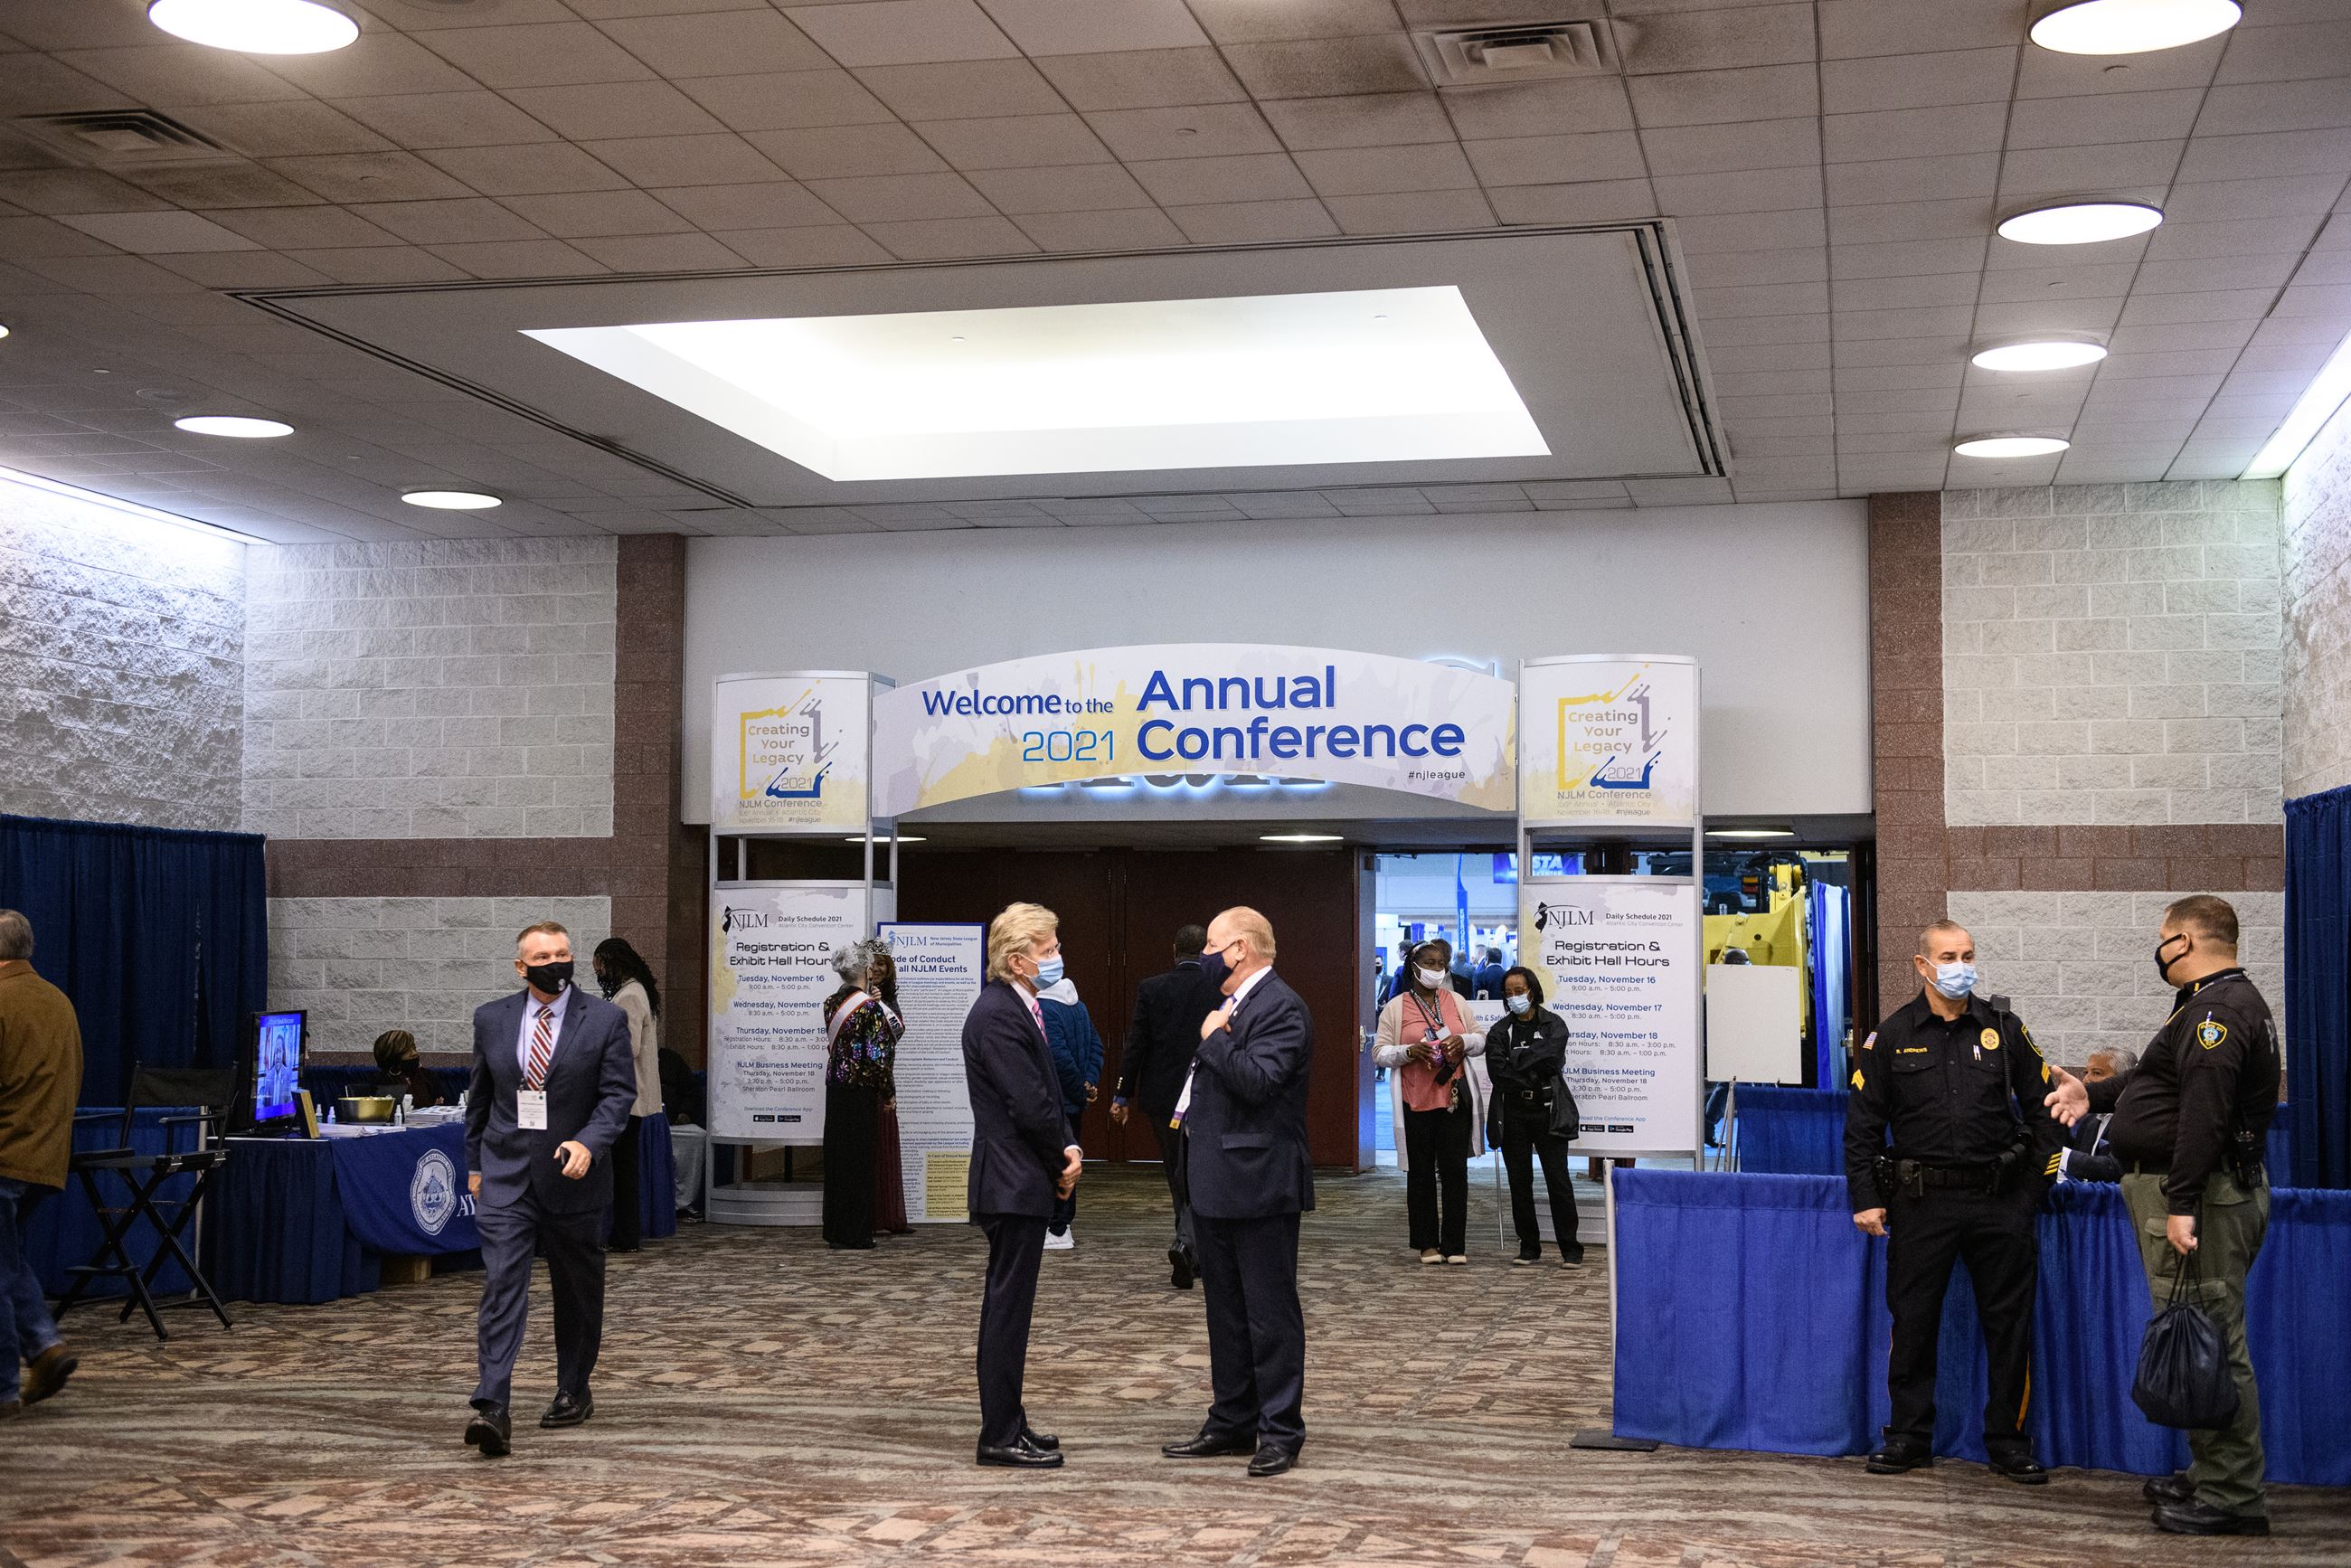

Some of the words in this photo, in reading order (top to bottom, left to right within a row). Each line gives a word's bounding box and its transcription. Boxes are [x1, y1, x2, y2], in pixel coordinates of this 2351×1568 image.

[1136, 665, 1336, 712] Annual
[922, 689, 1062, 715] Welcome
[1065, 699, 1082, 713] to
[1085, 698, 1114, 713] the
[1569, 710, 1638, 724] Creating
[748, 723, 809, 737] Creating
[1584, 727, 1622, 737] Your
[1137, 716, 1466, 760] Conference
[761, 740, 795, 749] Your
[1023, 731, 1114, 761] 2021
[1574, 741, 1632, 755] Legacy
[753, 754, 804, 766] Legacy
[1408, 770, 1466, 781] #njleague
[1608, 767, 1641, 779] 2021
[781, 777, 812, 789] 2021
[1557, 791, 1585, 799] NJLM
[1588, 790, 1651, 799] Conference
[739, 800, 761, 808] NJLM
[764, 799, 822, 808] Conference
[1616, 808, 1651, 817] #njleague
[788, 816, 822, 825] #njleague
[732, 913, 769, 931] NJLM
[1549, 910, 1594, 929] NJLM
[736, 941, 815, 954] Registration
[818, 942, 830, 951] &
[896, 936, 927, 948] NJLM
[1555, 940, 1645, 952] Registration
[1648, 941, 1661, 951] &
[730, 956, 765, 966] Exhibit
[769, 956, 792, 965] Hall
[796, 956, 832, 965] Hour
[909, 955, 918, 963] of
[920, 955, 956, 963] Conduct
[1547, 956, 1591, 965] Exhibit
[1595, 956, 1621, 965] Hall
[1625, 956, 1670, 967] Hours
[899, 965, 909, 973] all
[911, 965, 937, 973] NJLM
[939, 965, 968, 974] Events
[738, 975, 770, 983] Tuesday,
[1558, 976, 1596, 984] Tuesday,
[1599, 976, 1644, 984] November
[733, 1001, 776, 1009] Wednesday,
[1553, 1003, 1604, 1012] Wednesday,
[1606, 1004, 1652, 1012] November
[889, 1015, 901, 1031] MS
[736, 1026, 770, 1035] Thursday,
[1621, 1069, 1656, 1077] Meeting
